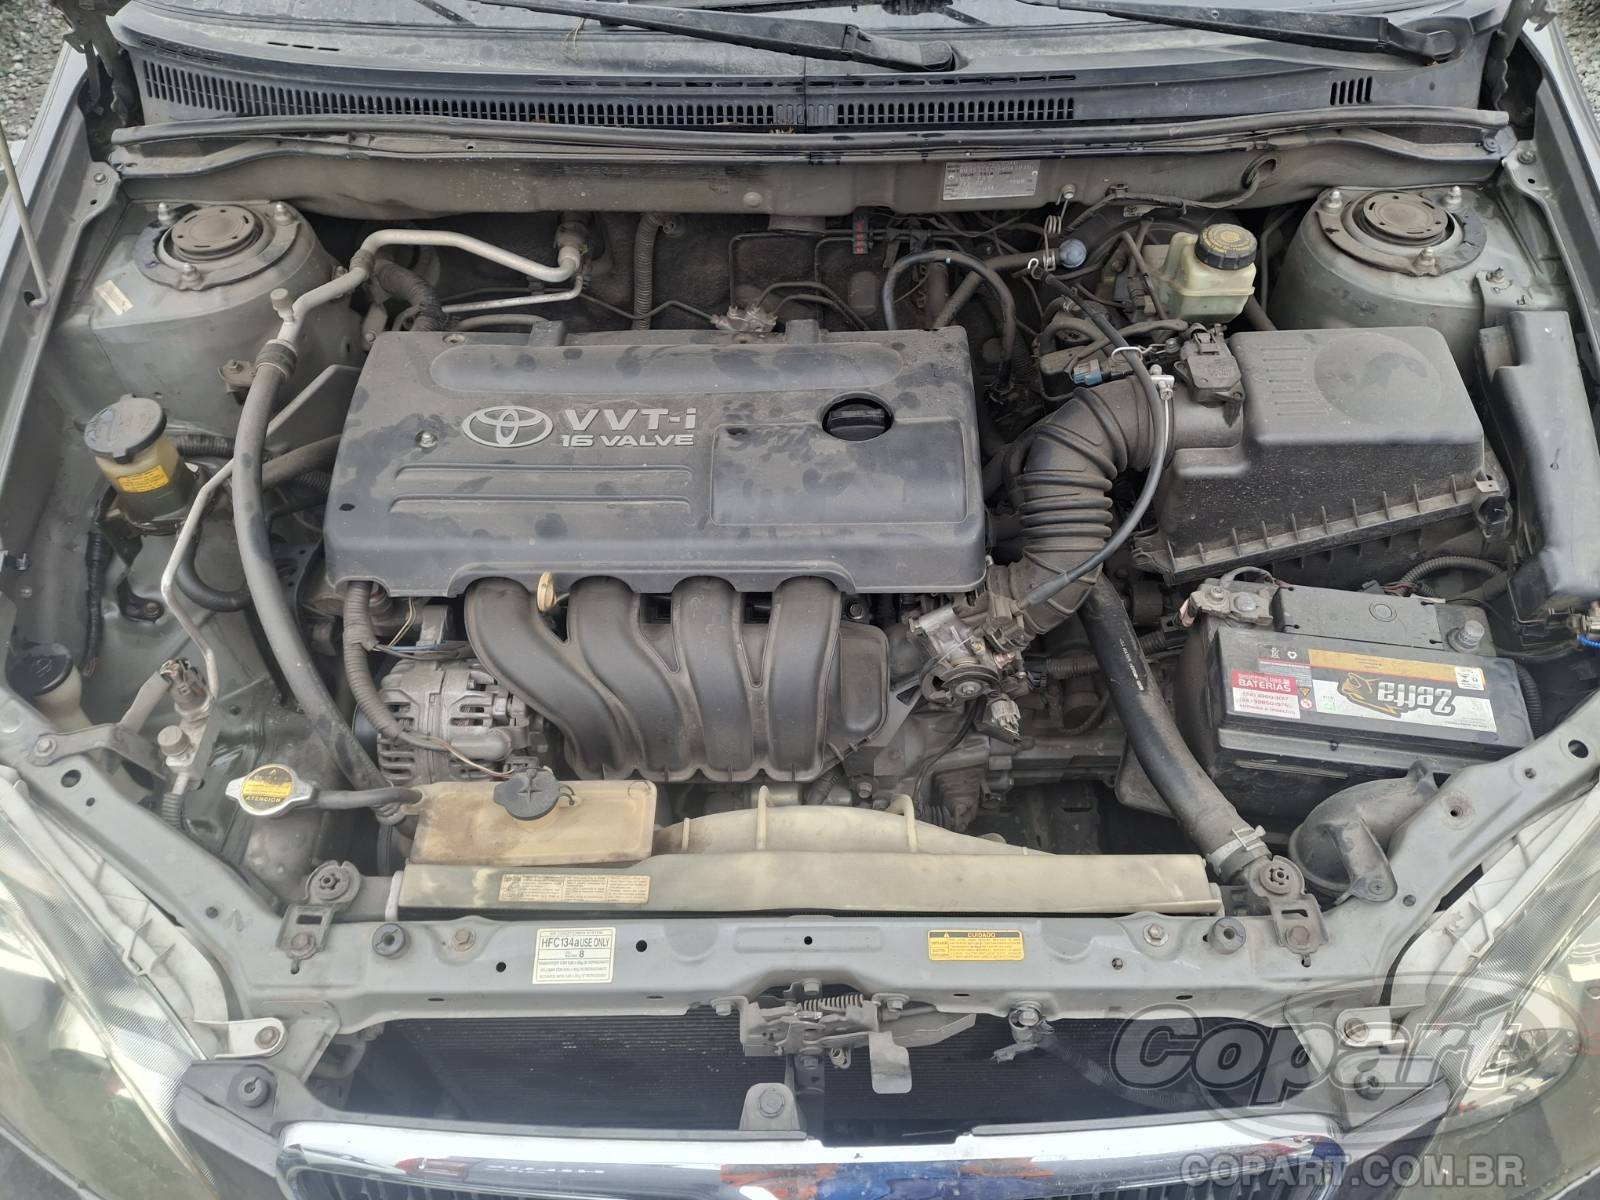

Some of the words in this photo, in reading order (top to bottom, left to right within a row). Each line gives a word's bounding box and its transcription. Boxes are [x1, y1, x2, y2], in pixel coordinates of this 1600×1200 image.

[564, 408, 697, 431] VVT-i
[560, 434, 594, 447] 16
[600, 434, 694, 447] VALVE
[1238, 678, 1291, 693] BATERIAS
[1378, 681, 1452, 713] Zetta
[580, 937, 592, 947] USE
[593, 937, 610, 947] ONLY
